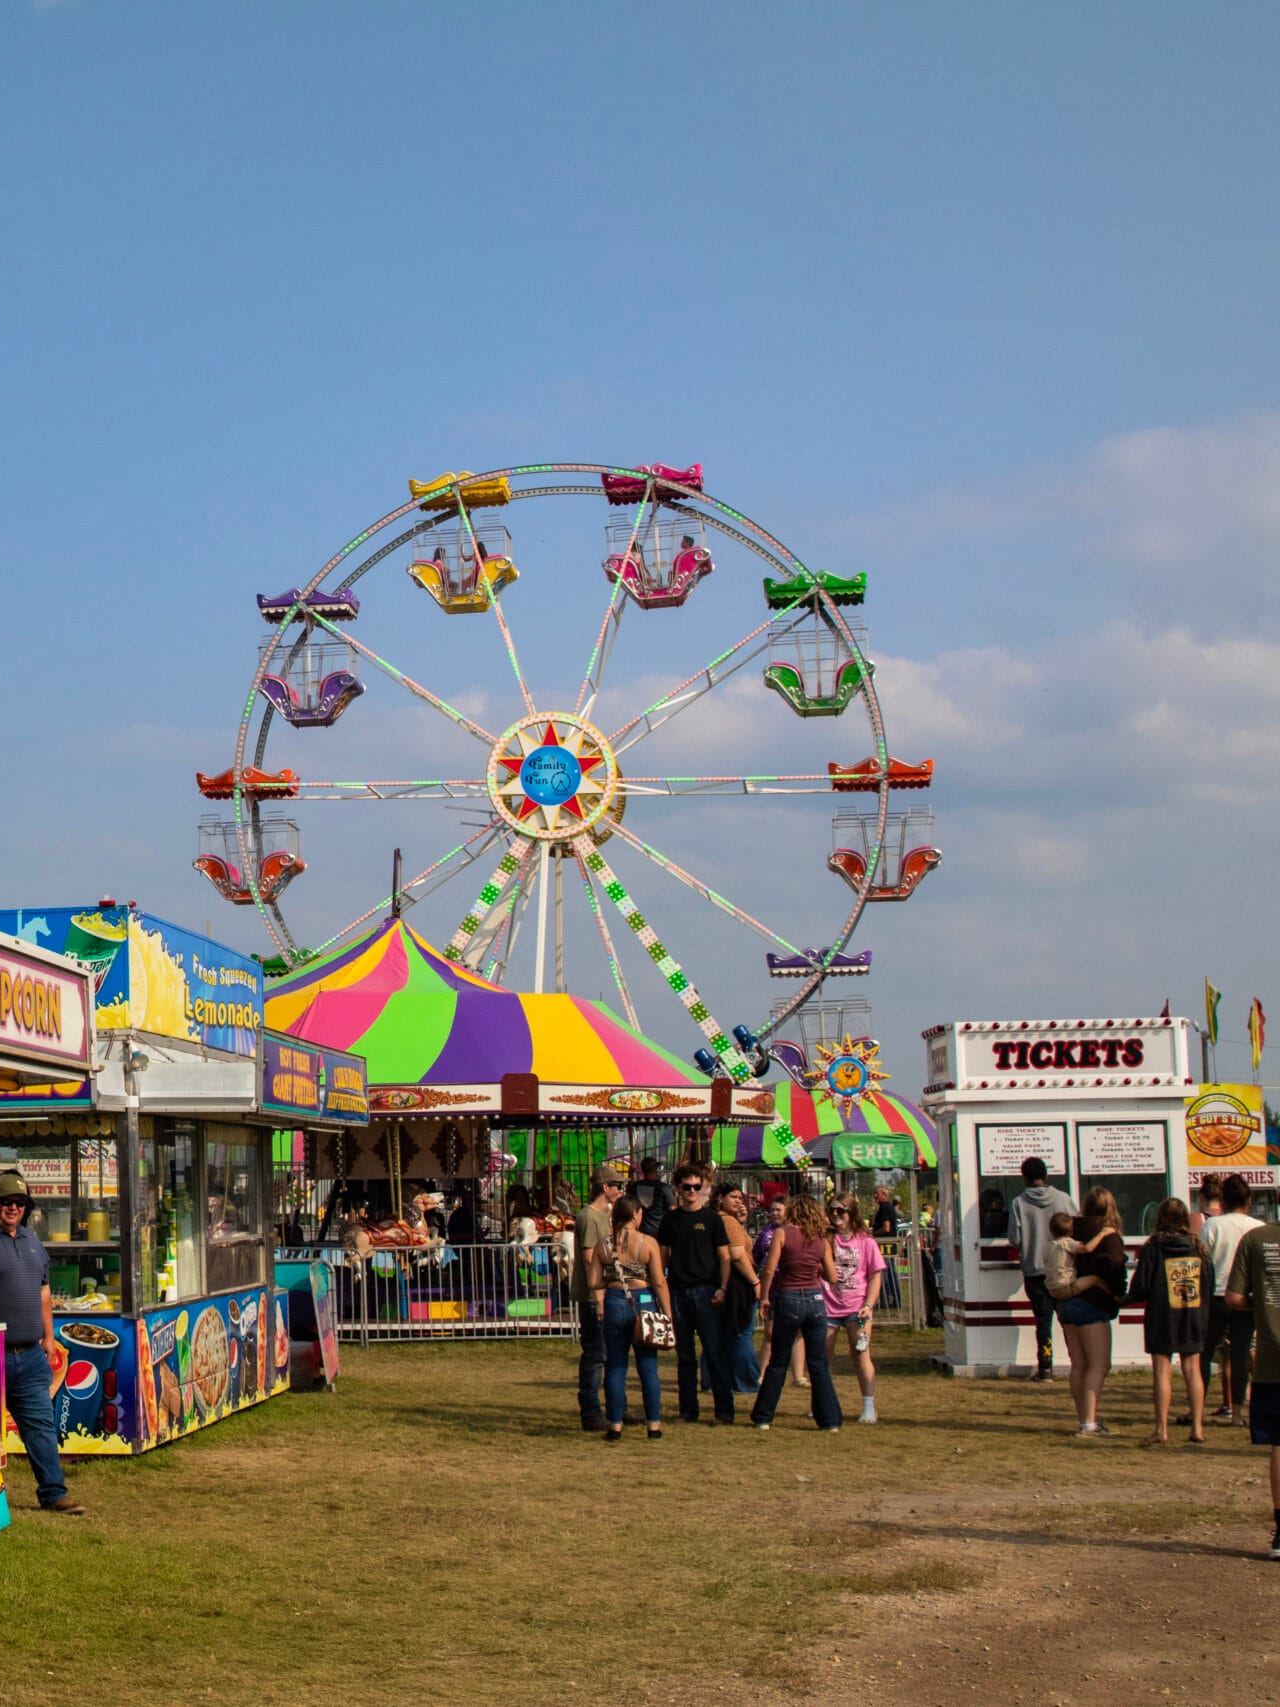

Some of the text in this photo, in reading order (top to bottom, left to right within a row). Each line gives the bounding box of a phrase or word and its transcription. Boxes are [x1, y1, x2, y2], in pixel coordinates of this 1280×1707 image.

[528, 756, 566, 770] Family
[525, 772, 548, 785] Fun
[193, 953, 257, 995] Fresh Squeezed
[184, 984, 261, 1030] Lemonade
[992, 1038, 1144, 1070] TICKETS
[1185, 1114, 1258, 1128] NE GUY'S FRIES
[851, 1143, 895, 1160] EXIT
[1239, 1171, 1274, 1184] FRIES
[60, 1394, 70, 1433] pepsi
